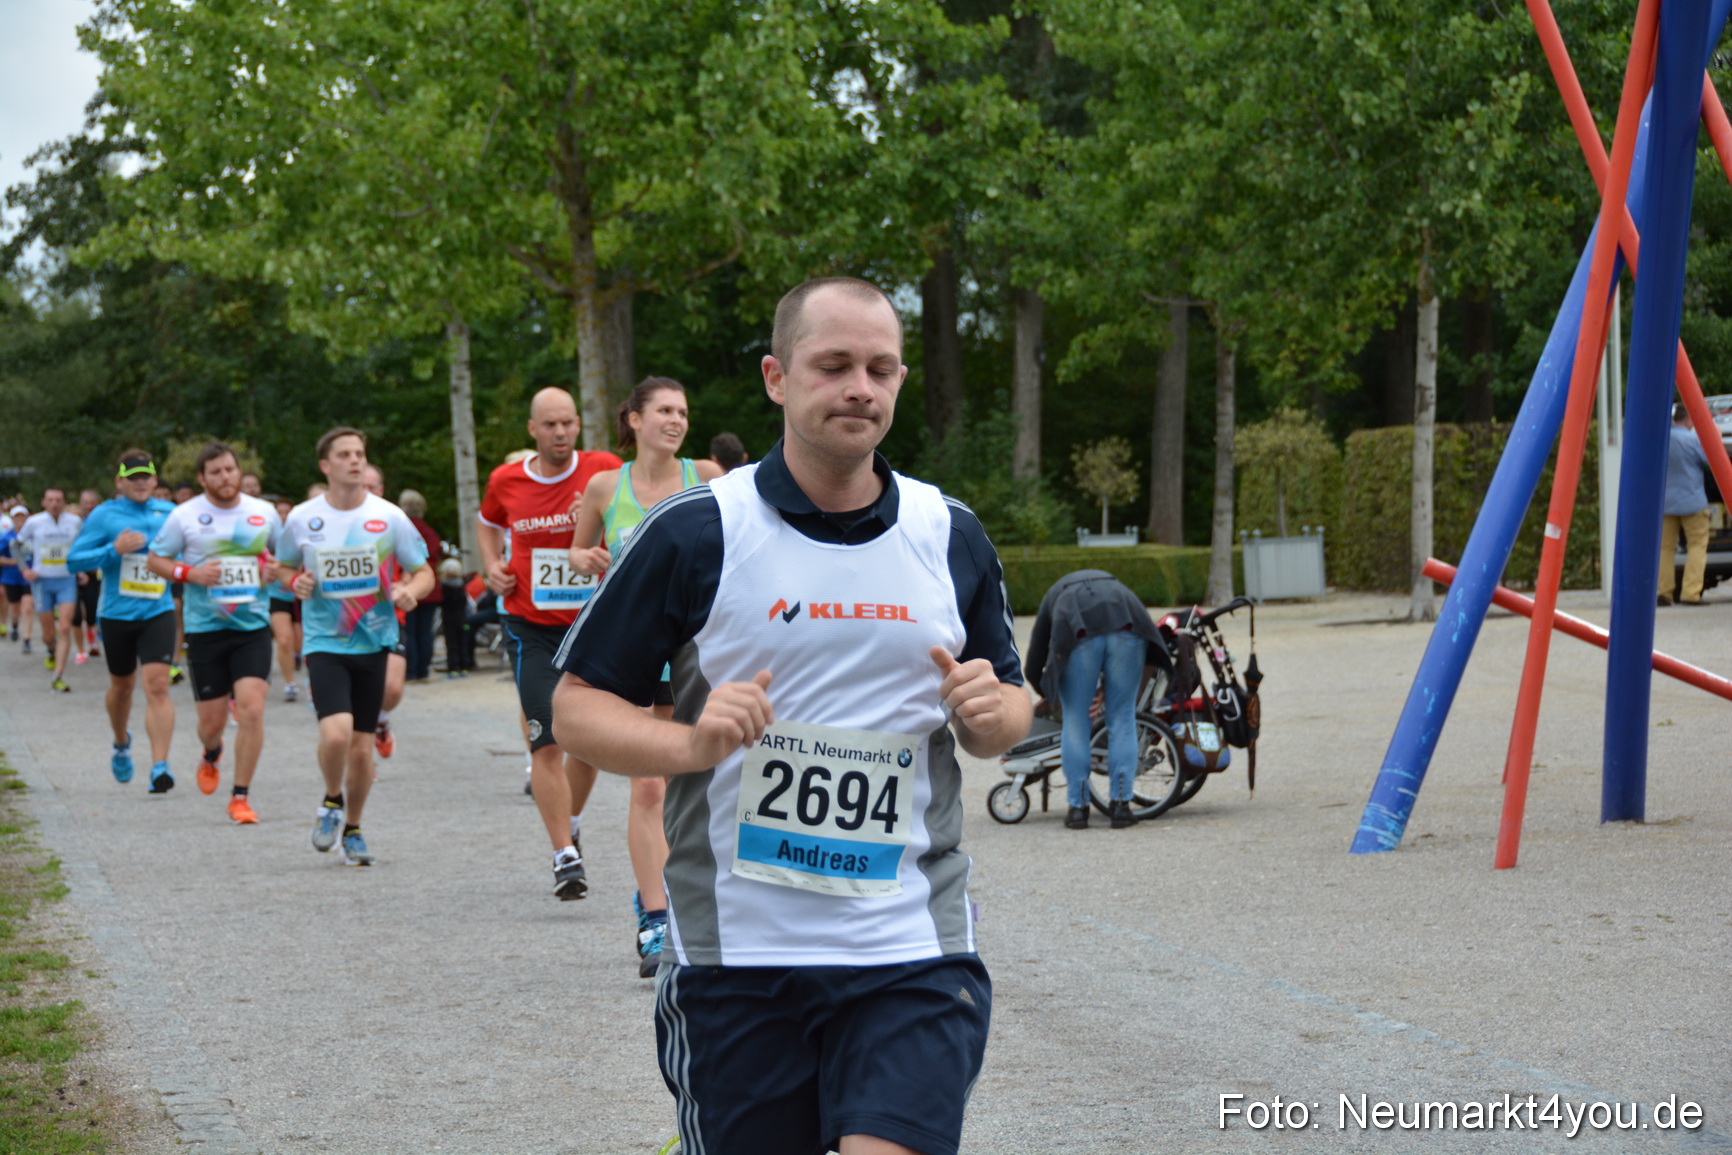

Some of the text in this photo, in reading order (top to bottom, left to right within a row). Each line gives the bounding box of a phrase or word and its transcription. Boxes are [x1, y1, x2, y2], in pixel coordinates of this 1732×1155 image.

[214, 567, 254, 585] 541
[324, 557, 373, 578] 2505
[548, 591, 583, 601] Andreas
[809, 603, 918, 623] KLEBL
[759, 733, 892, 764] ARTL Neumarkt
[757, 759, 899, 834] 2694
[776, 839, 869, 873] Andreas
